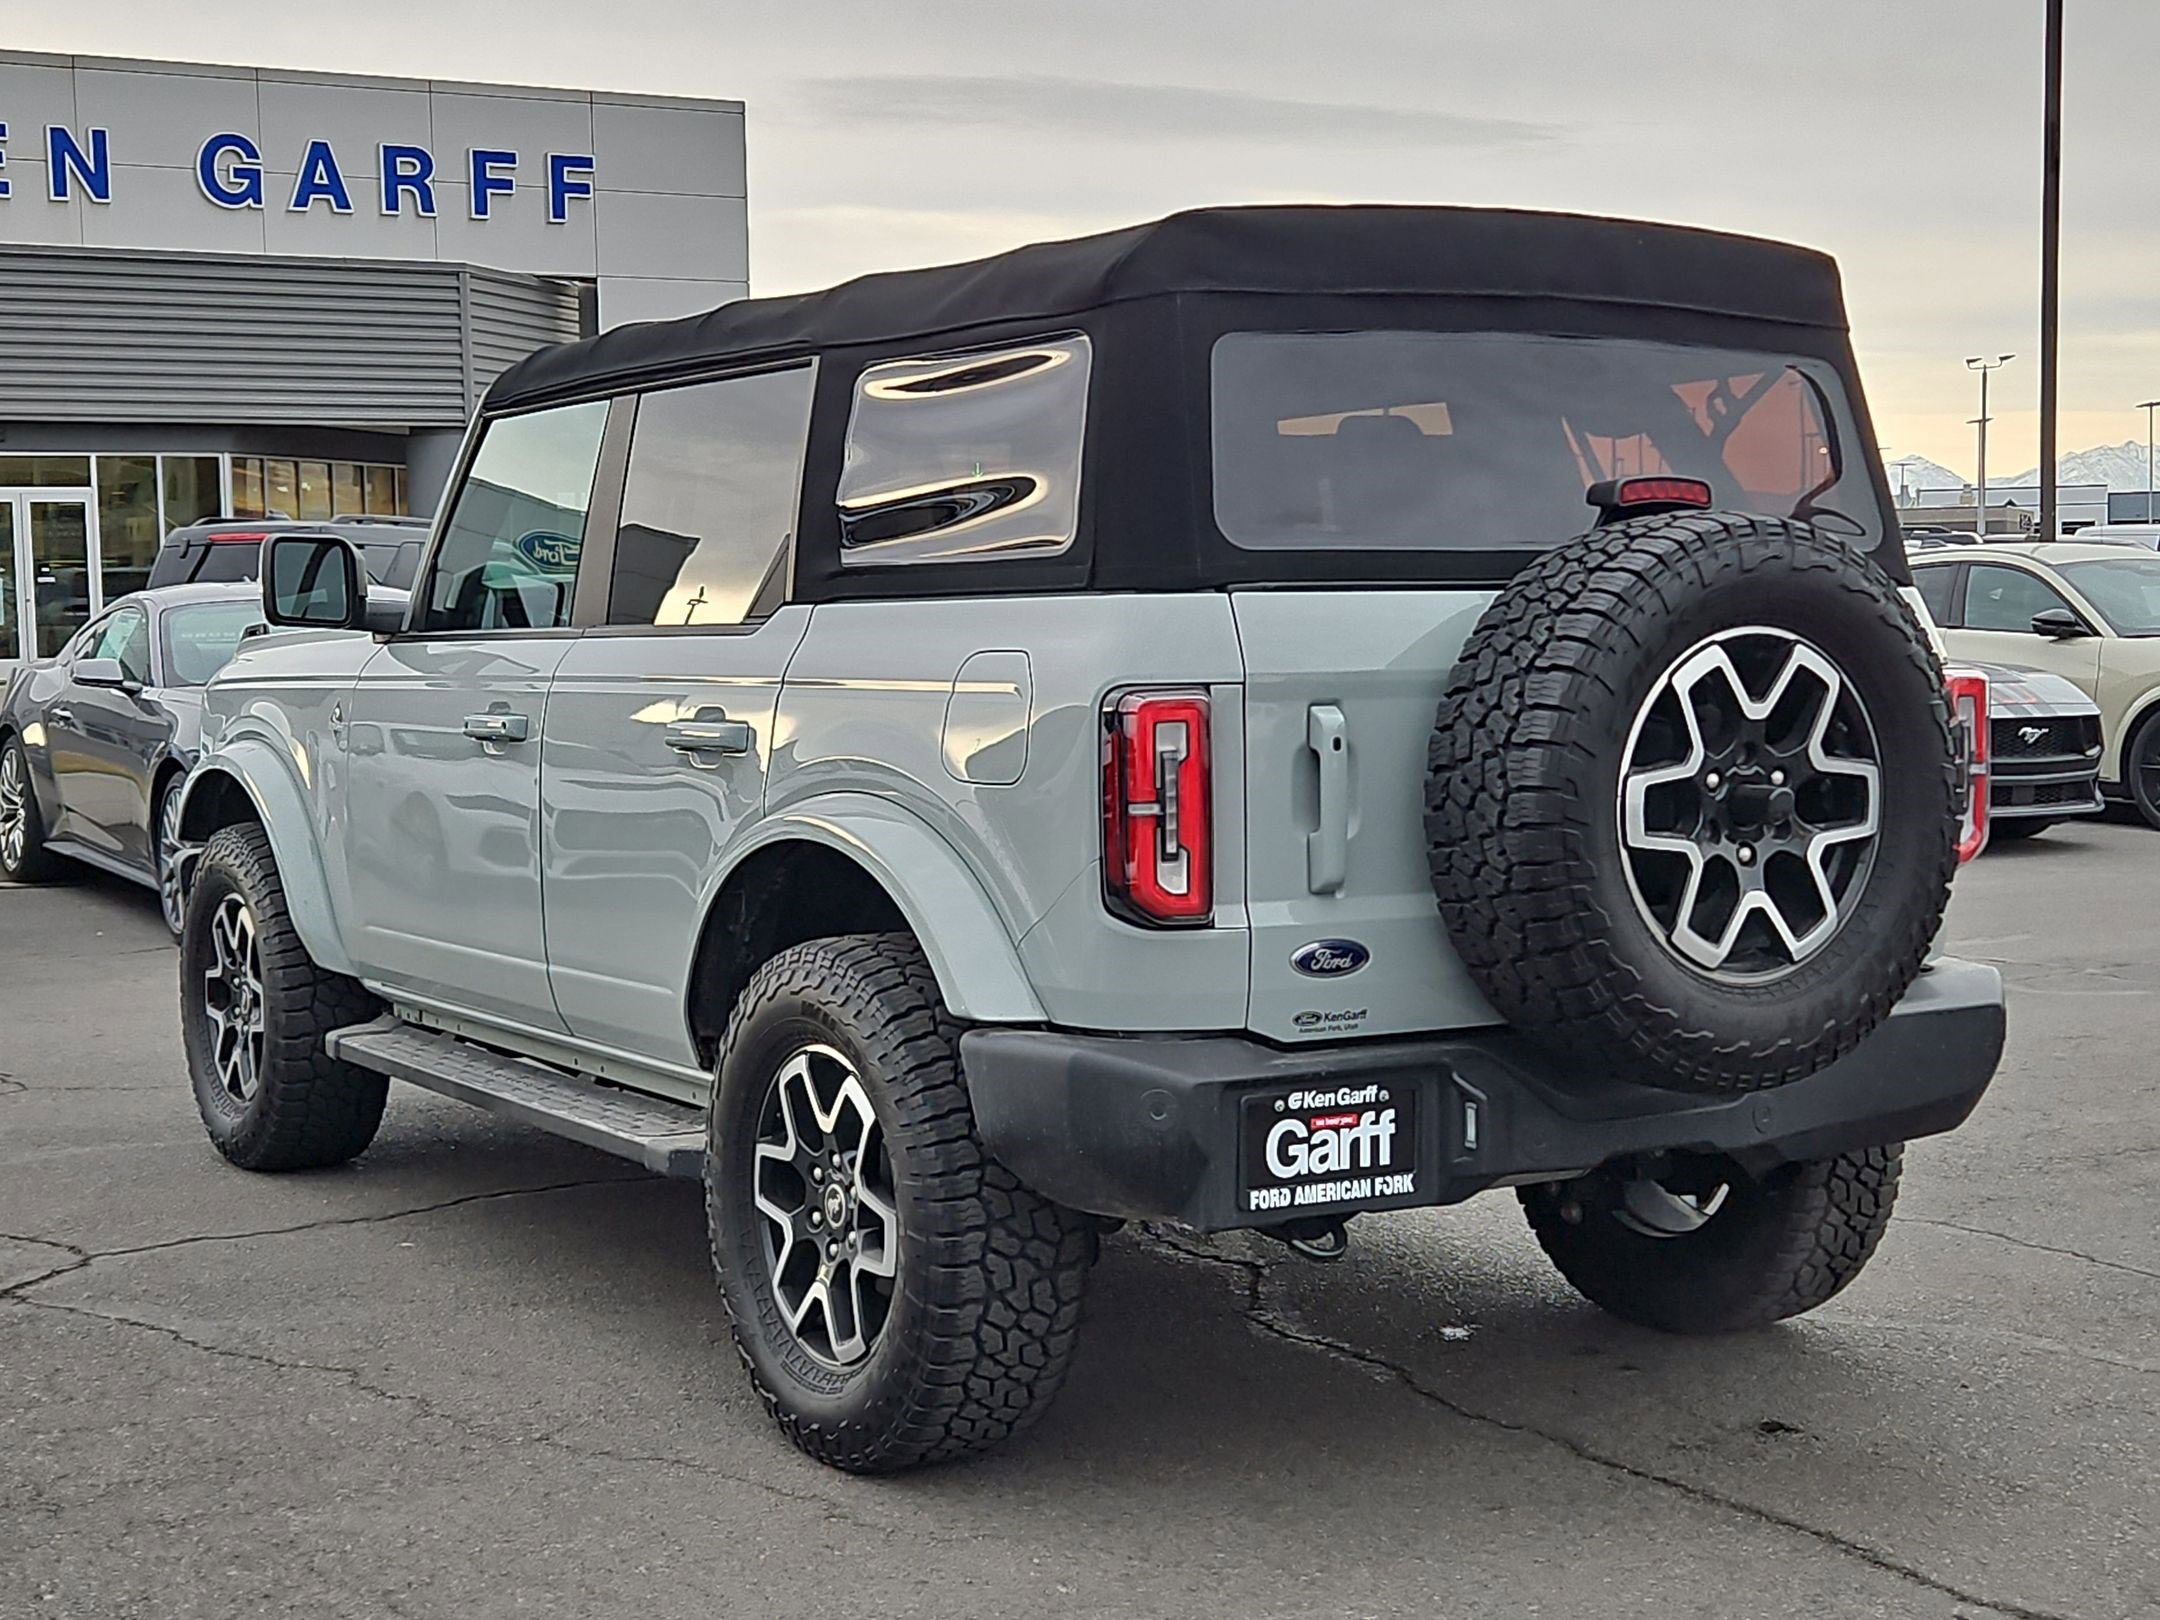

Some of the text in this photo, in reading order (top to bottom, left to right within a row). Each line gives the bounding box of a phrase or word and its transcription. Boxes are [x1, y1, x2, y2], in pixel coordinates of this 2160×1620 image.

[0, 122, 596, 225] N GARFF
[1311, 948, 1354, 970] Ford
[1266, 1109, 1396, 1179] Garff
[1249, 1173, 1415, 1211] FORD AMERICAN FORK
